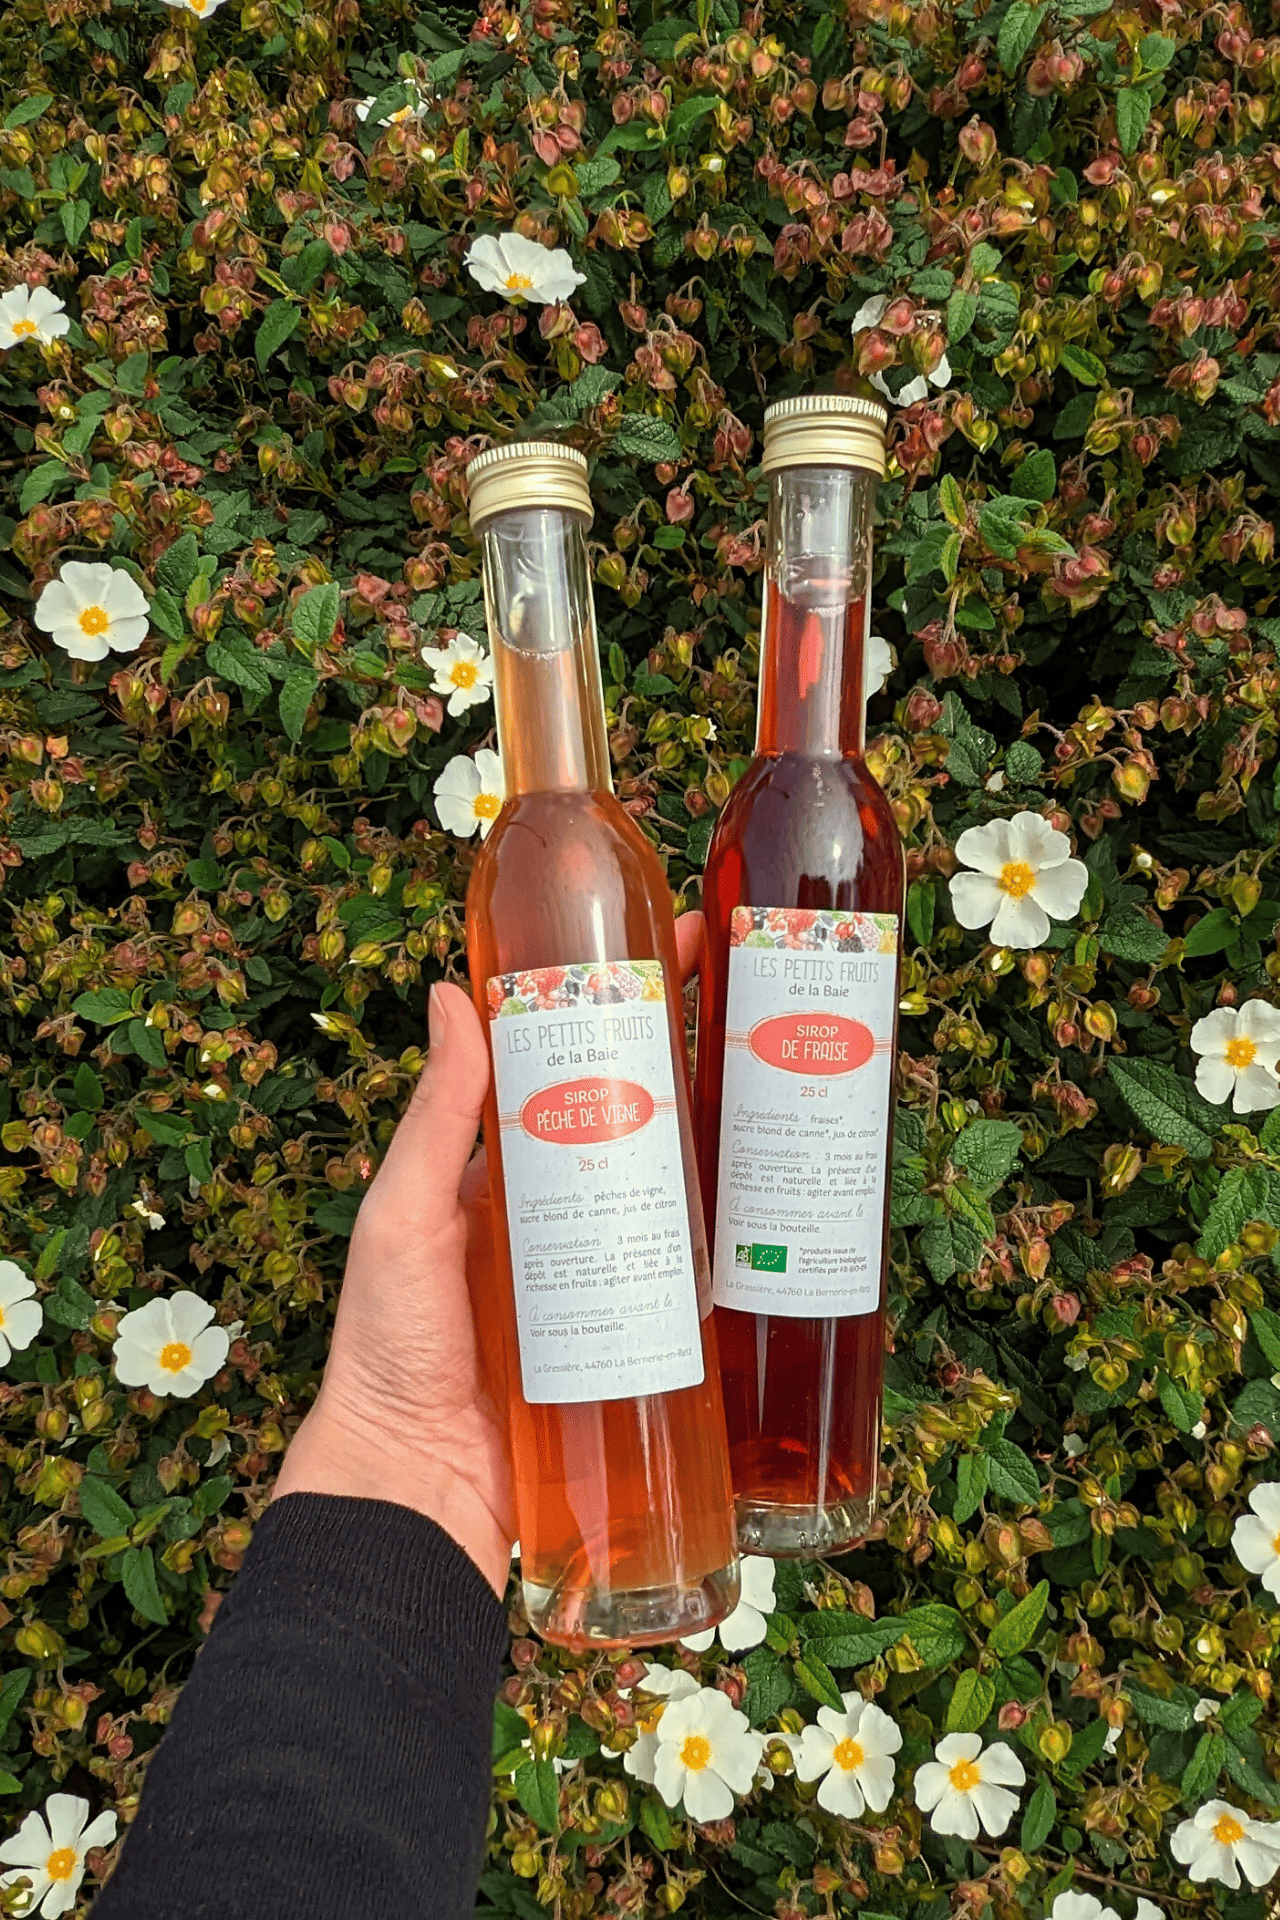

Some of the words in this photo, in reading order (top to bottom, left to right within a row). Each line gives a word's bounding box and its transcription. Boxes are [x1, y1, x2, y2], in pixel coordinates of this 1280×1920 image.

[753, 957, 777, 978] LES
[784, 958, 833, 981] PETITS
[840, 961, 879, 982] FRUITS
[789, 984, 804, 995] de
[809, 985, 819, 996] la
[823, 985, 849, 997] Baie
[507, 1028, 531, 1054] LES
[539, 1021, 595, 1049] PETITS
[604, 1016, 653, 1042] FRUITS
[796, 1025, 838, 1038] SIROP
[547, 1053, 564, 1067] de
[570, 1051, 582, 1064] la
[587, 1048, 618, 1062] Baie
[782, 1039, 799, 1059] DE
[804, 1040, 849, 1061] FRAISE
[564, 1088, 609, 1105] SIROP
[800, 1086, 815, 1097] 25
[818, 1086, 828, 1098] cl
[537, 1109, 577, 1132] PÊCHE
[580, 1108, 596, 1127] DE
[602, 1103, 640, 1124] VIGNE
[733, 1124, 754, 1133] sucre
[757, 1126, 782, 1135] blond
[785, 1127, 796, 1136] de
[833, 1130, 845, 1140] jus
[847, 1130, 856, 1138] de
[732, 1140, 811, 1159] Conservation
[825, 1153, 831, 1161] 3
[834, 1152, 852, 1160] mois
[579, 1157, 595, 1171] 25
[598, 1155, 608, 1169] cl
[732, 1160, 752, 1170] après
[759, 1164, 803, 1173] ouverture.
[812, 1166, 821, 1174] La
[828, 1166, 861, 1176] présence
[731, 1172, 753, 1180] dépôt
[761, 1175, 774, 1183] est
[782, 1176, 821, 1185] naturelle
[518, 1192, 584, 1212] Ingrédients
[594, 1192, 627, 1203] pêches
[630, 1188, 640, 1198] de
[642, 1186, 665, 1198] vigne,
[730, 1182, 763, 1192] richesse
[776, 1186, 801, 1196] fruits
[807, 1188, 832, 1199] agiter
[520, 1215, 539, 1224] sucre
[544, 1212, 568, 1222] blond
[573, 1210, 584, 1219] de
[589, 1207, 619, 1217] canne,
[623, 1204, 637, 1216] jus
[641, 1202, 651, 1211] de
[655, 1200, 676, 1210] citron
[743, 1205, 813, 1218] consommer
[817, 1208, 853, 1218] avant
[856, 1203, 863, 1217] le
[729, 1218, 744, 1226] Voir
[747, 1221, 767, 1229] sous
[770, 1222, 777, 1231] la
[780, 1222, 822, 1233] bouteille.
[523, 1236, 602, 1253] Conservation
[617, 1236, 623, 1244] 3
[627, 1232, 648, 1244] mois
[652, 1232, 661, 1240] au
[664, 1229, 680, 1238] frais
[524, 1260, 544, 1269] après
[550, 1255, 597, 1267] ouverture.
[605, 1253, 615, 1262] La
[623, 1247, 661, 1261] présence
[667, 1244, 681, 1253] d'un
[525, 1271, 546, 1282] dépôt
[576, 1265, 617, 1277] naturelle
[626, 1262, 635, 1271] et
[644, 1258, 658, 1268] liée
[665, 1256, 670, 1265] à
[676, 1255, 682, 1263] la
[526, 1282, 557, 1292] richesse
[559, 1280, 570, 1290] en
[572, 1279, 597, 1289] fruits
[604, 1276, 630, 1287] agiter
[633, 1272, 656, 1282] avant
[726, 1280, 734, 1288] La
[777, 1288, 802, 1296] 44760
[804, 1288, 813, 1296] La
[542, 1308, 614, 1321] consommer
[619, 1298, 660, 1314] avant
[664, 1293, 672, 1307] le
[530, 1328, 545, 1337] Voir
[548, 1327, 568, 1336] sous
[571, 1325, 579, 1335] la
[582, 1321, 627, 1335] bouteille.
[534, 1365, 542, 1373] La
[585, 1359, 612, 1370] 44760
[615, 1357, 625, 1367] La
